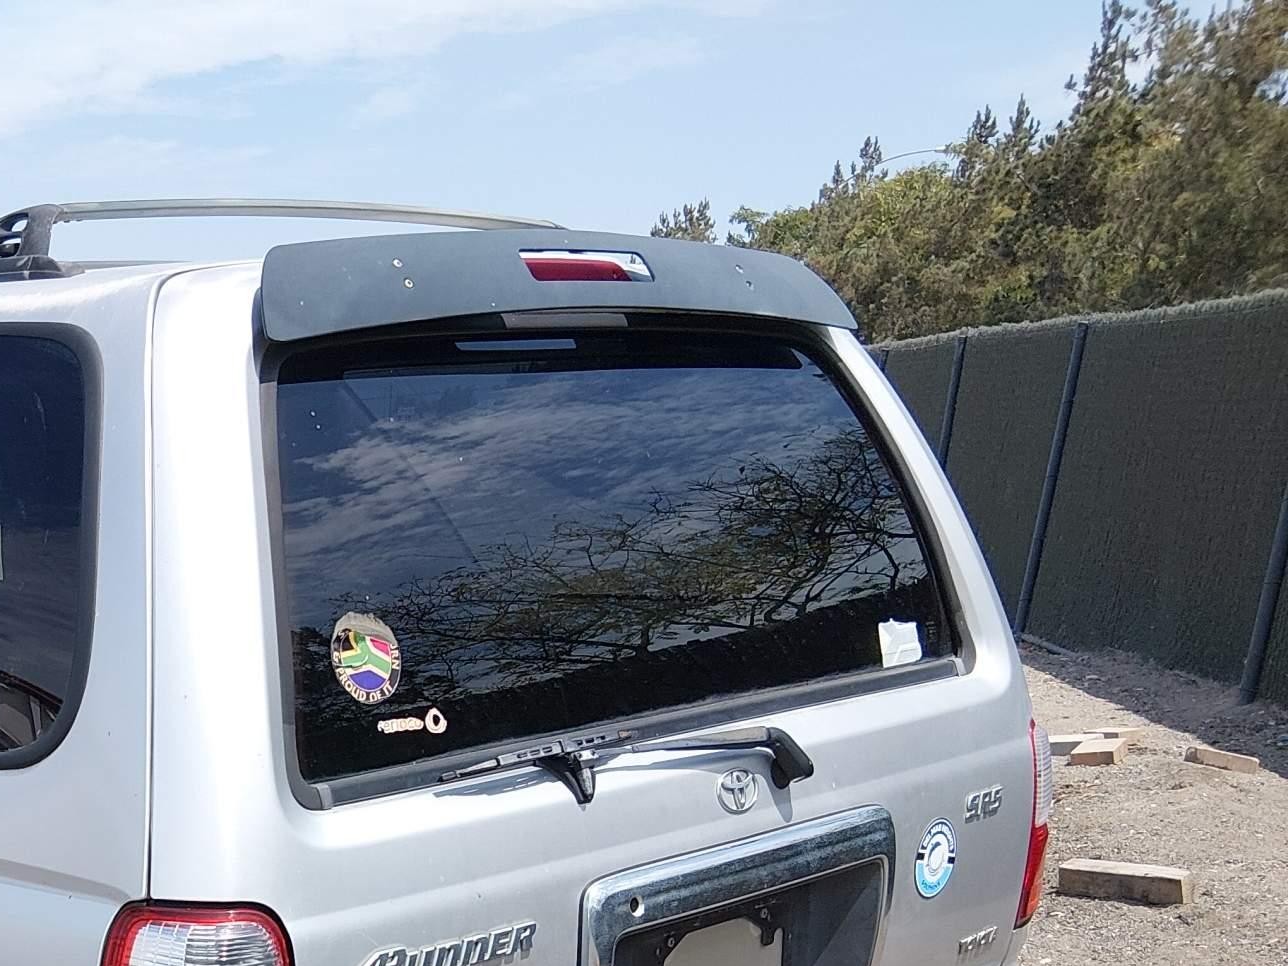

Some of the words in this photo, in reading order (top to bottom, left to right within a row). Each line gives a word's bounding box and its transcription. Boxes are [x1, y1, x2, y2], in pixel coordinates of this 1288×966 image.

[336, 667, 367, 700] PROUD
[369, 690, 383, 702] OF
[383, 679, 394, 696] IT
